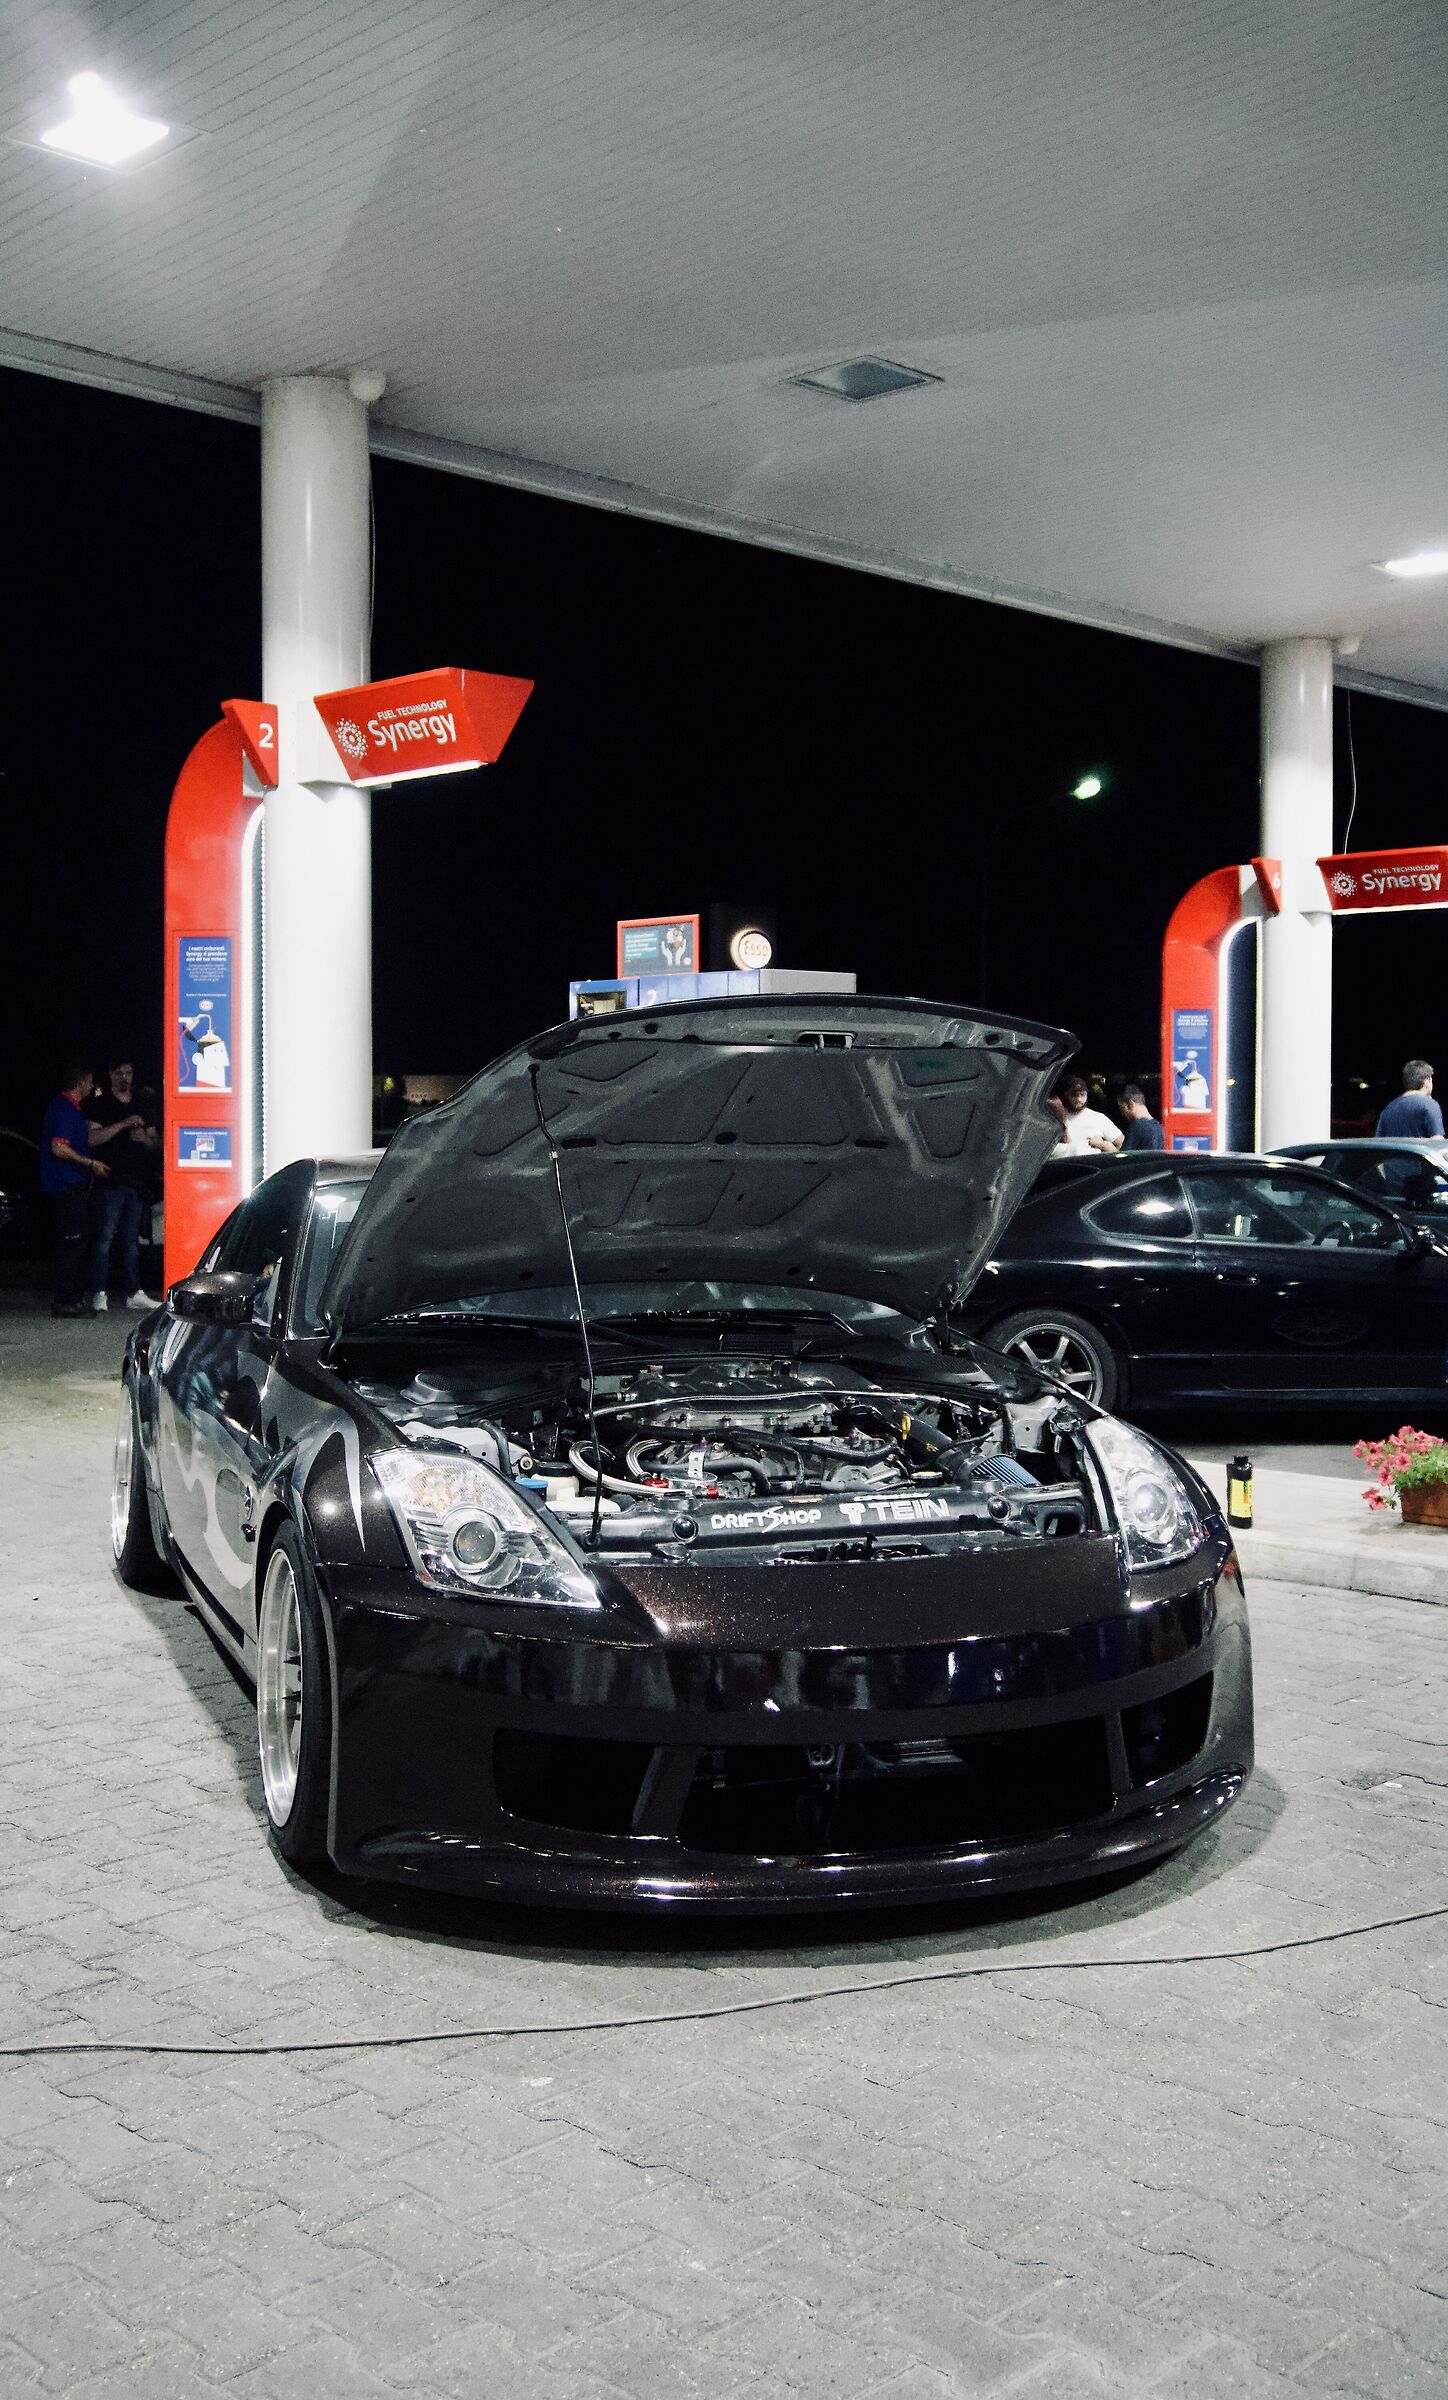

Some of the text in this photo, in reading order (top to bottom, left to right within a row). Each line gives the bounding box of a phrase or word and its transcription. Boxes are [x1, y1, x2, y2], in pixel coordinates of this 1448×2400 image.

[377, 699, 448, 720] FUEL TECHNOLOGY
[259, 722, 274, 748] 2
[367, 713, 457, 752] Synergy
[1272, 872, 1281, 889] 6
[1373, 864, 1439, 875] FUEL TECHNOLOGY
[1361, 872, 1442, 895] Synergy
[710, 1505, 822, 1533] DRIFTSHOP
[867, 1498, 950, 1521] TEIN
